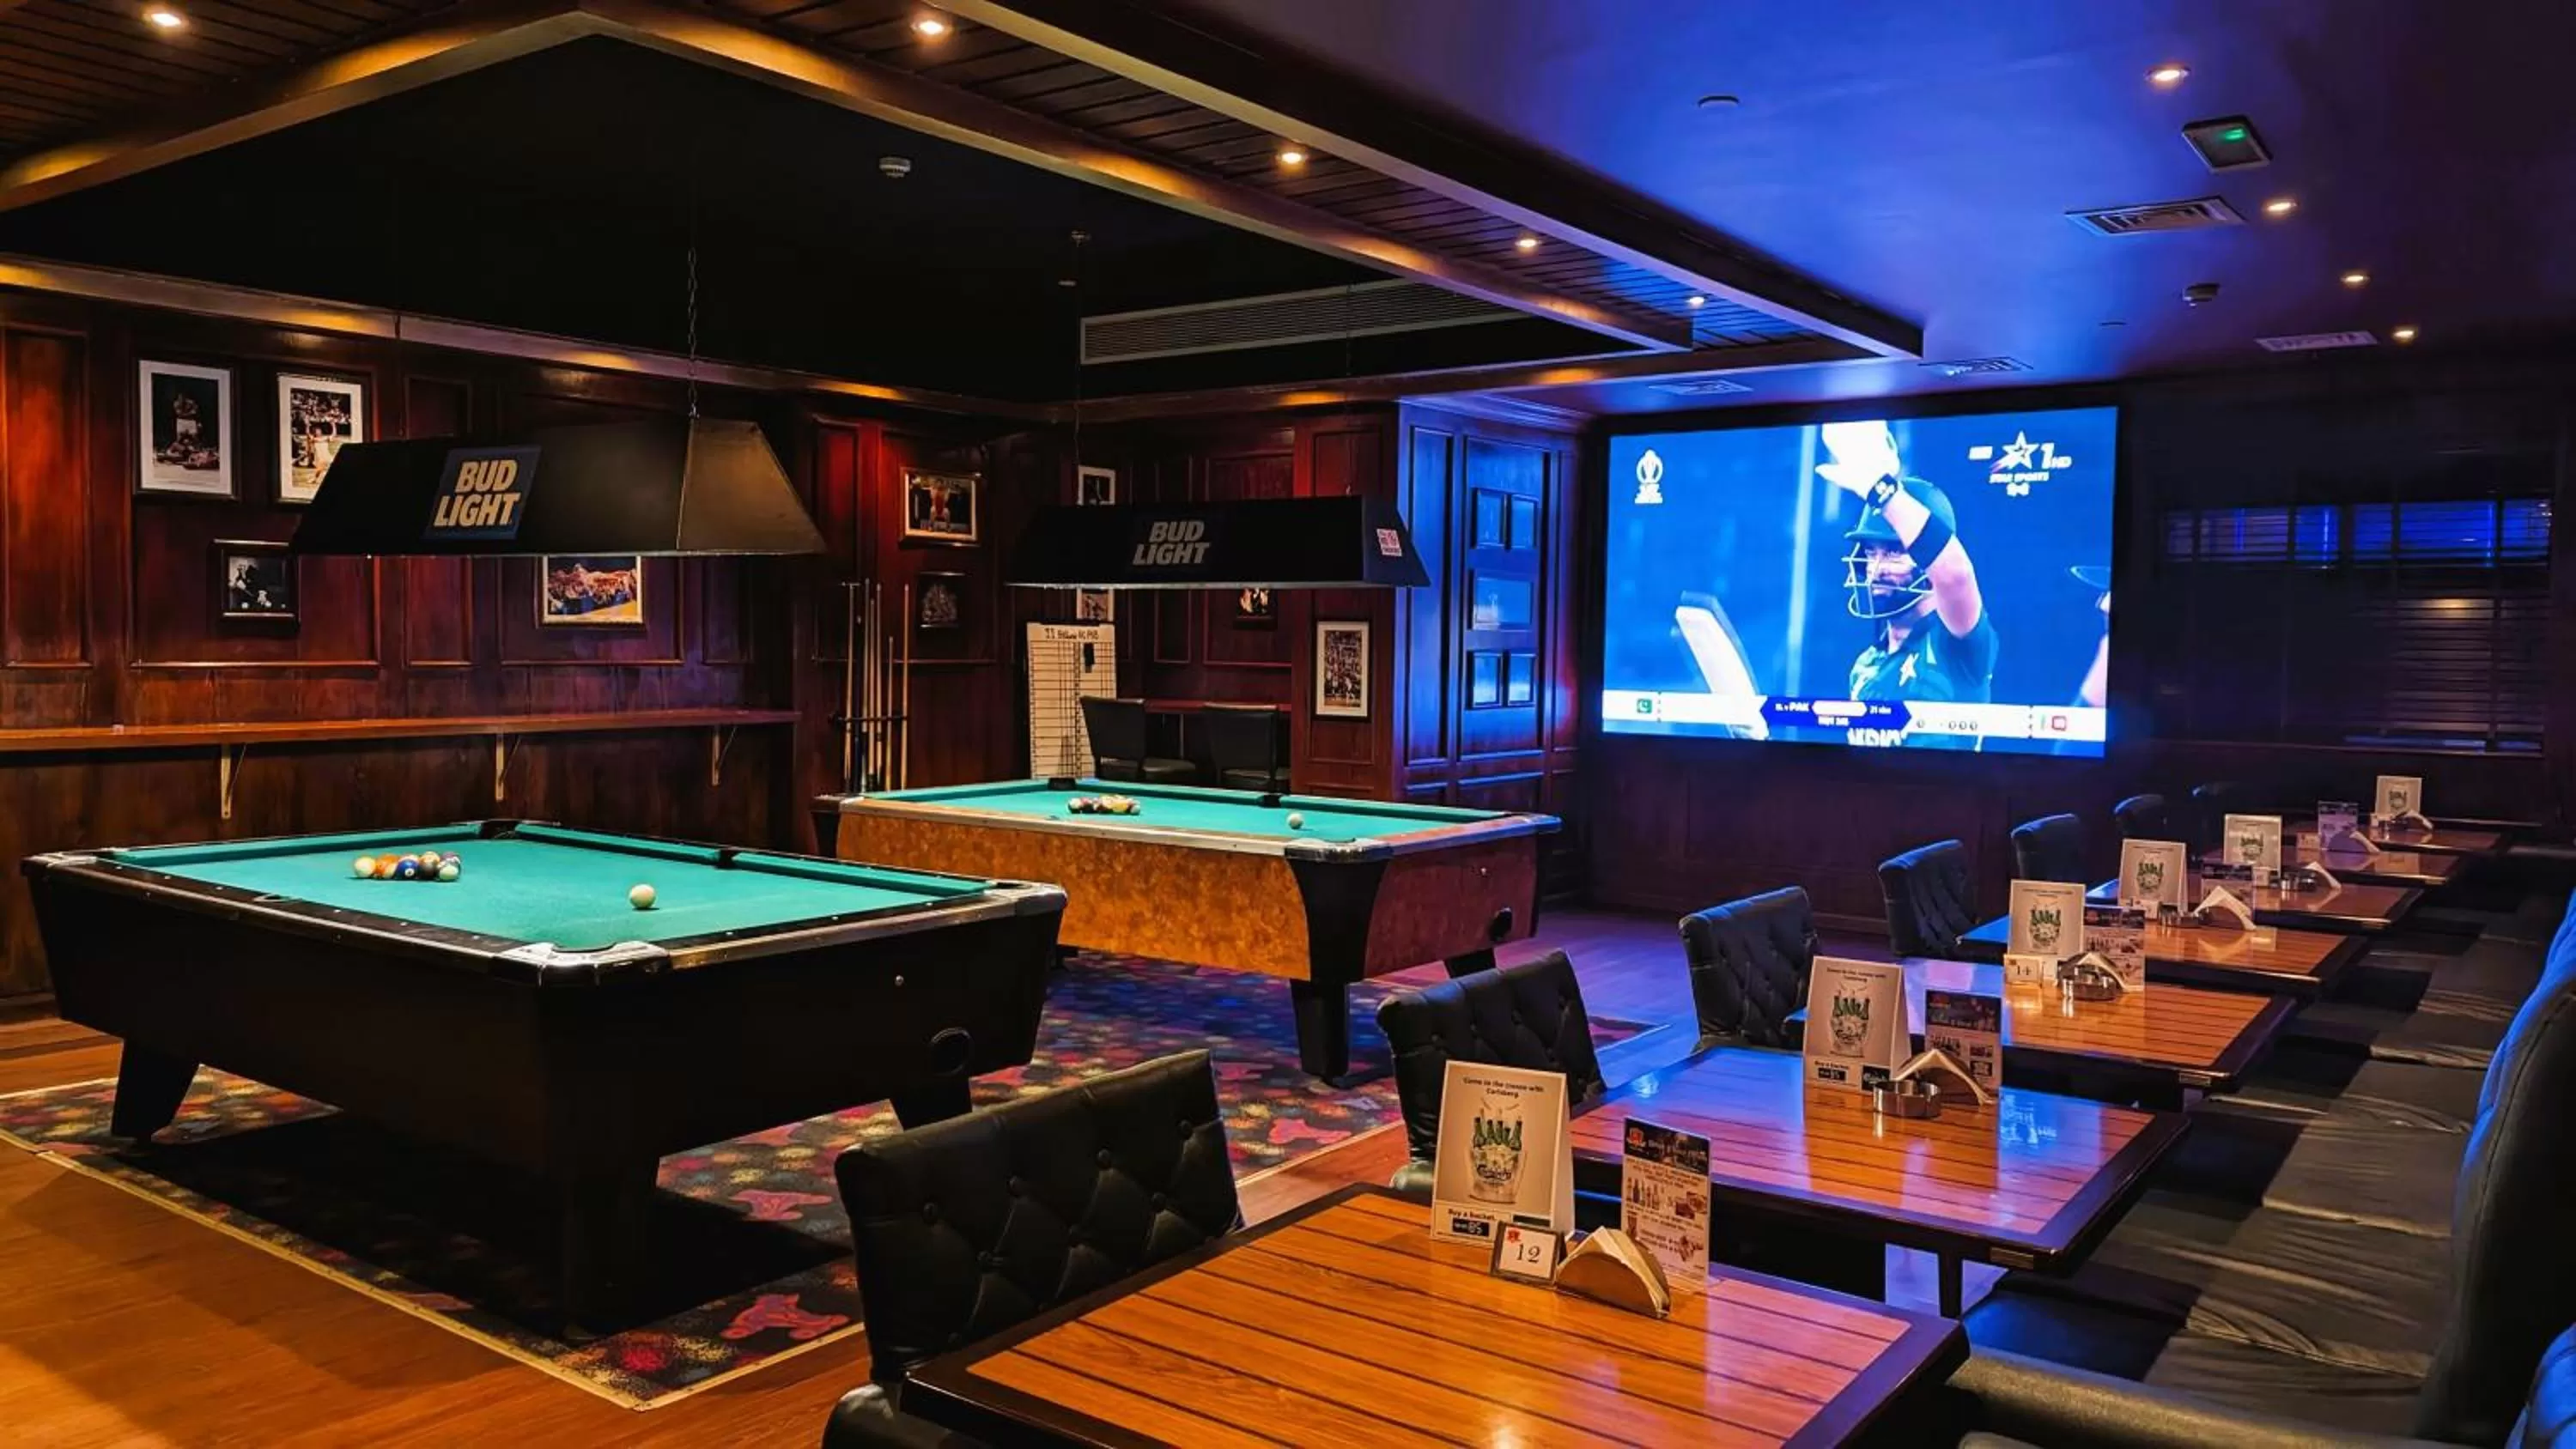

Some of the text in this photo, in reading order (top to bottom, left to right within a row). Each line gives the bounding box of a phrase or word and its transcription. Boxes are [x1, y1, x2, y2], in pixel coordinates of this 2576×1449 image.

[455, 459, 518, 492] BUD
[434, 492, 521, 527] LIGHT
[1149, 520, 1205, 543] BUD
[1133, 542, 1211, 566] LIGHT
[1516, 1243, 1541, 1264] 12
